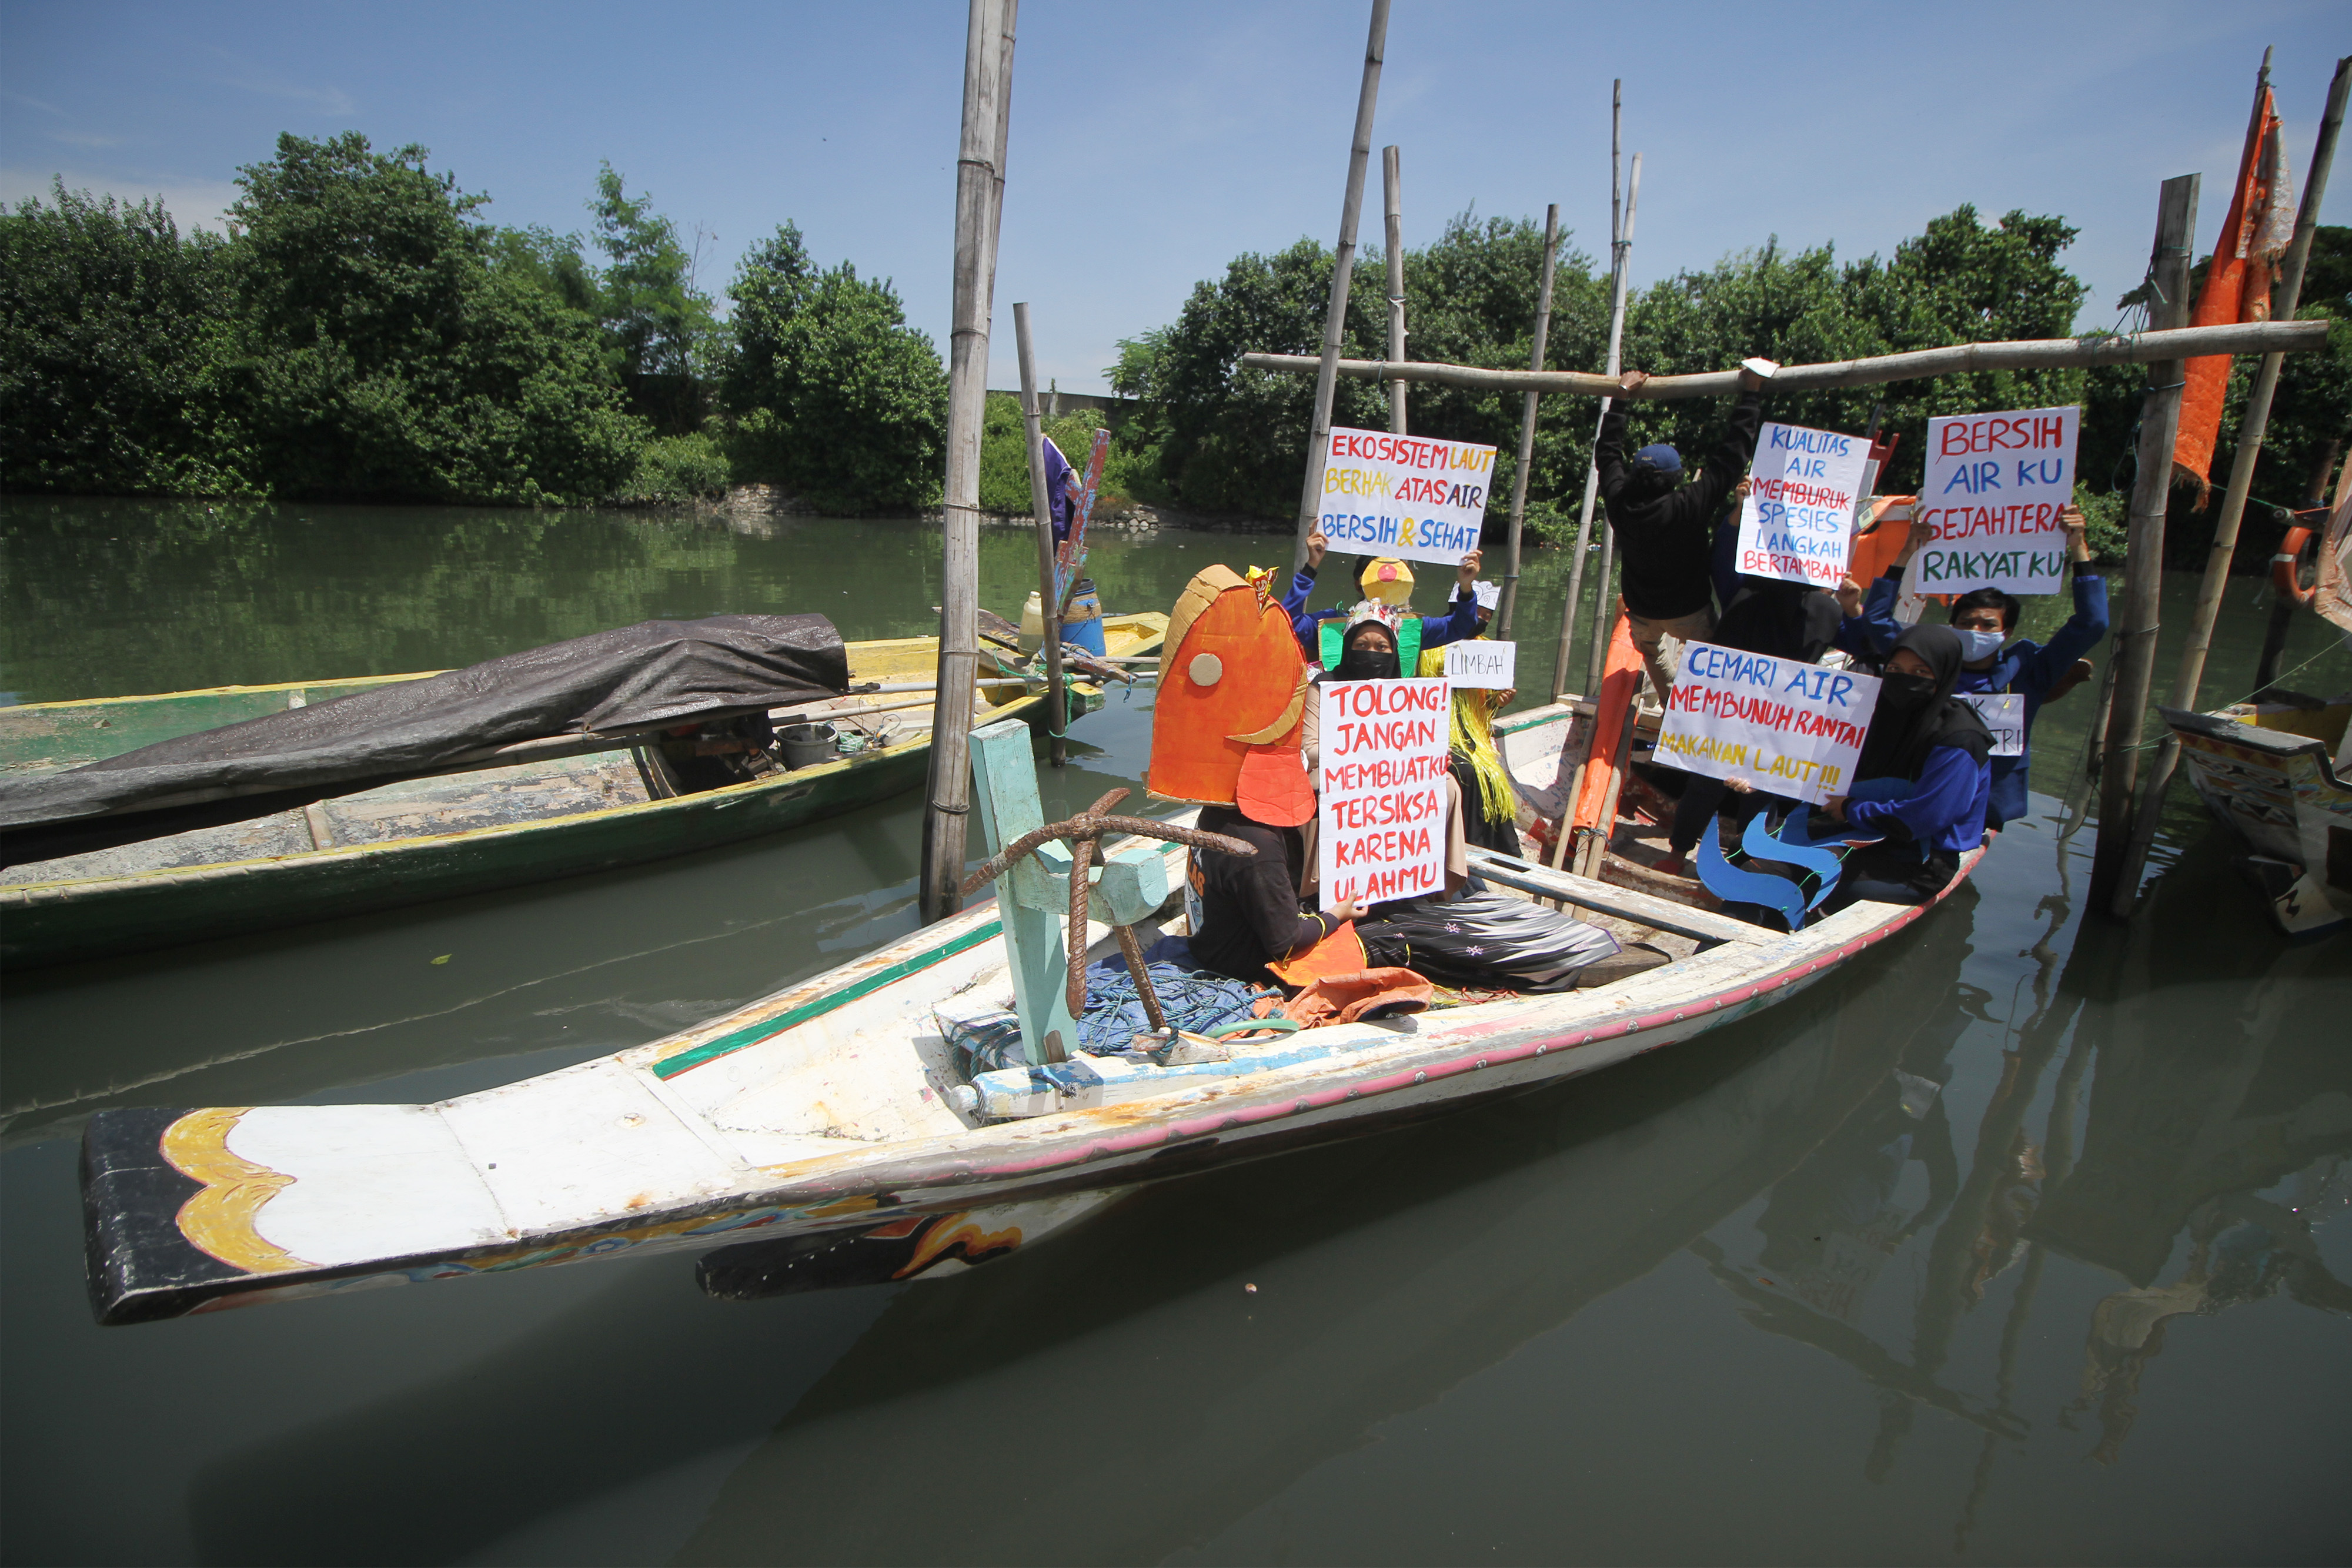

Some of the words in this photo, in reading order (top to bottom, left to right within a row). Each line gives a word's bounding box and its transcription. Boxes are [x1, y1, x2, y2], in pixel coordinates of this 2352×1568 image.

[1332, 436, 1448, 470] EKOSISTEM
[1449, 447, 1496, 472] LAUT
[1770, 426, 1850, 457] KUALITAS
[1935, 416, 2063, 465] BERSIH
[1786, 457, 1826, 479] AIR
[1943, 461, 2002, 494] AIR
[2017, 458, 2062, 486] KU
[1325, 468, 1394, 499] BERHAK
[1395, 477, 1448, 504] ATAS
[1446, 484, 1482, 509] AIR
[1753, 477, 1851, 511] MEMBURUK
[1322, 514, 1398, 544] BERSIH
[1398, 517, 1416, 547] &
[1418, 519, 1478, 551] SEHAT
[1758, 503, 1839, 533] SPESIES
[1923, 503, 2064, 541] SEJAHTERA
[1756, 529, 1841, 559] LANGKAH
[1744, 550, 1845, 583] BERTAMBAH
[1451, 653, 1504, 675] LIMBAH
[1688, 647, 1778, 688] CEMARI
[1785, 668, 1853, 707] AIR
[1329, 681, 1448, 717] TOLONG!
[1669, 684, 1794, 732] MEMBUNUH
[1793, 710, 1866, 749] RANTAI
[1334, 718, 1435, 755] JANGAN
[1659, 731, 1748, 766] MAKANAN
[1325, 755, 1447, 793] MEMBUATKU
[1331, 789, 1438, 830] TERSIKSA
[1336, 827, 1430, 868] KARENA
[1334, 862, 1436, 903] ULAHMU
